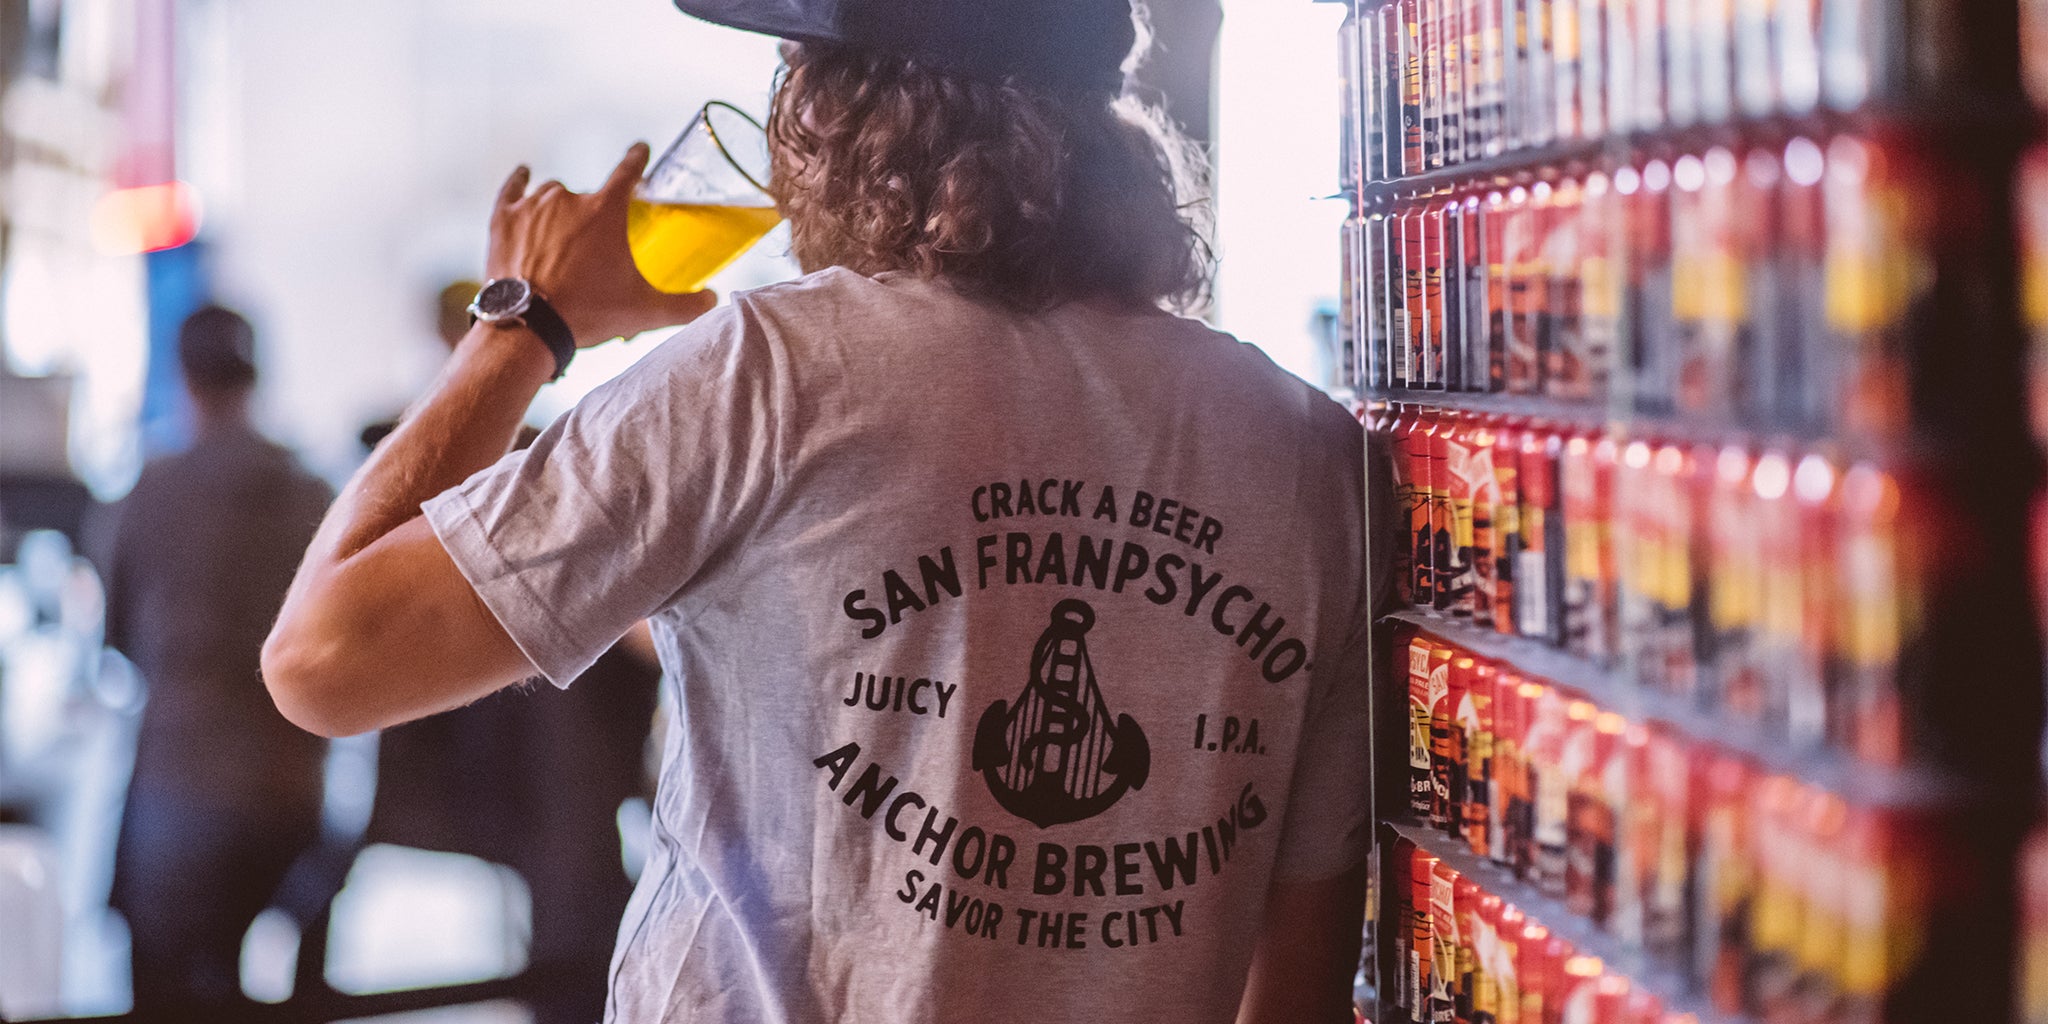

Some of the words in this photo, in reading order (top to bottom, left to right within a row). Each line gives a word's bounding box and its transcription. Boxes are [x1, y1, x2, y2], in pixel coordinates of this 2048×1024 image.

[971, 478, 1085, 523] CRACK
[1092, 485, 1117, 523] A
[1129, 490, 1223, 555] BEER
[843, 545, 963, 640] SAN
[843, 672, 957, 719] JUICY
[1194, 713, 1265, 755] I.P.A.
[812, 741, 1017, 890] ANCHOR
[1033, 775, 1268, 897] BREWING
[896, 869, 1003, 940] SAVOR
[1016, 907, 1088, 949] THE
[1101, 900, 1184, 948] CITY
